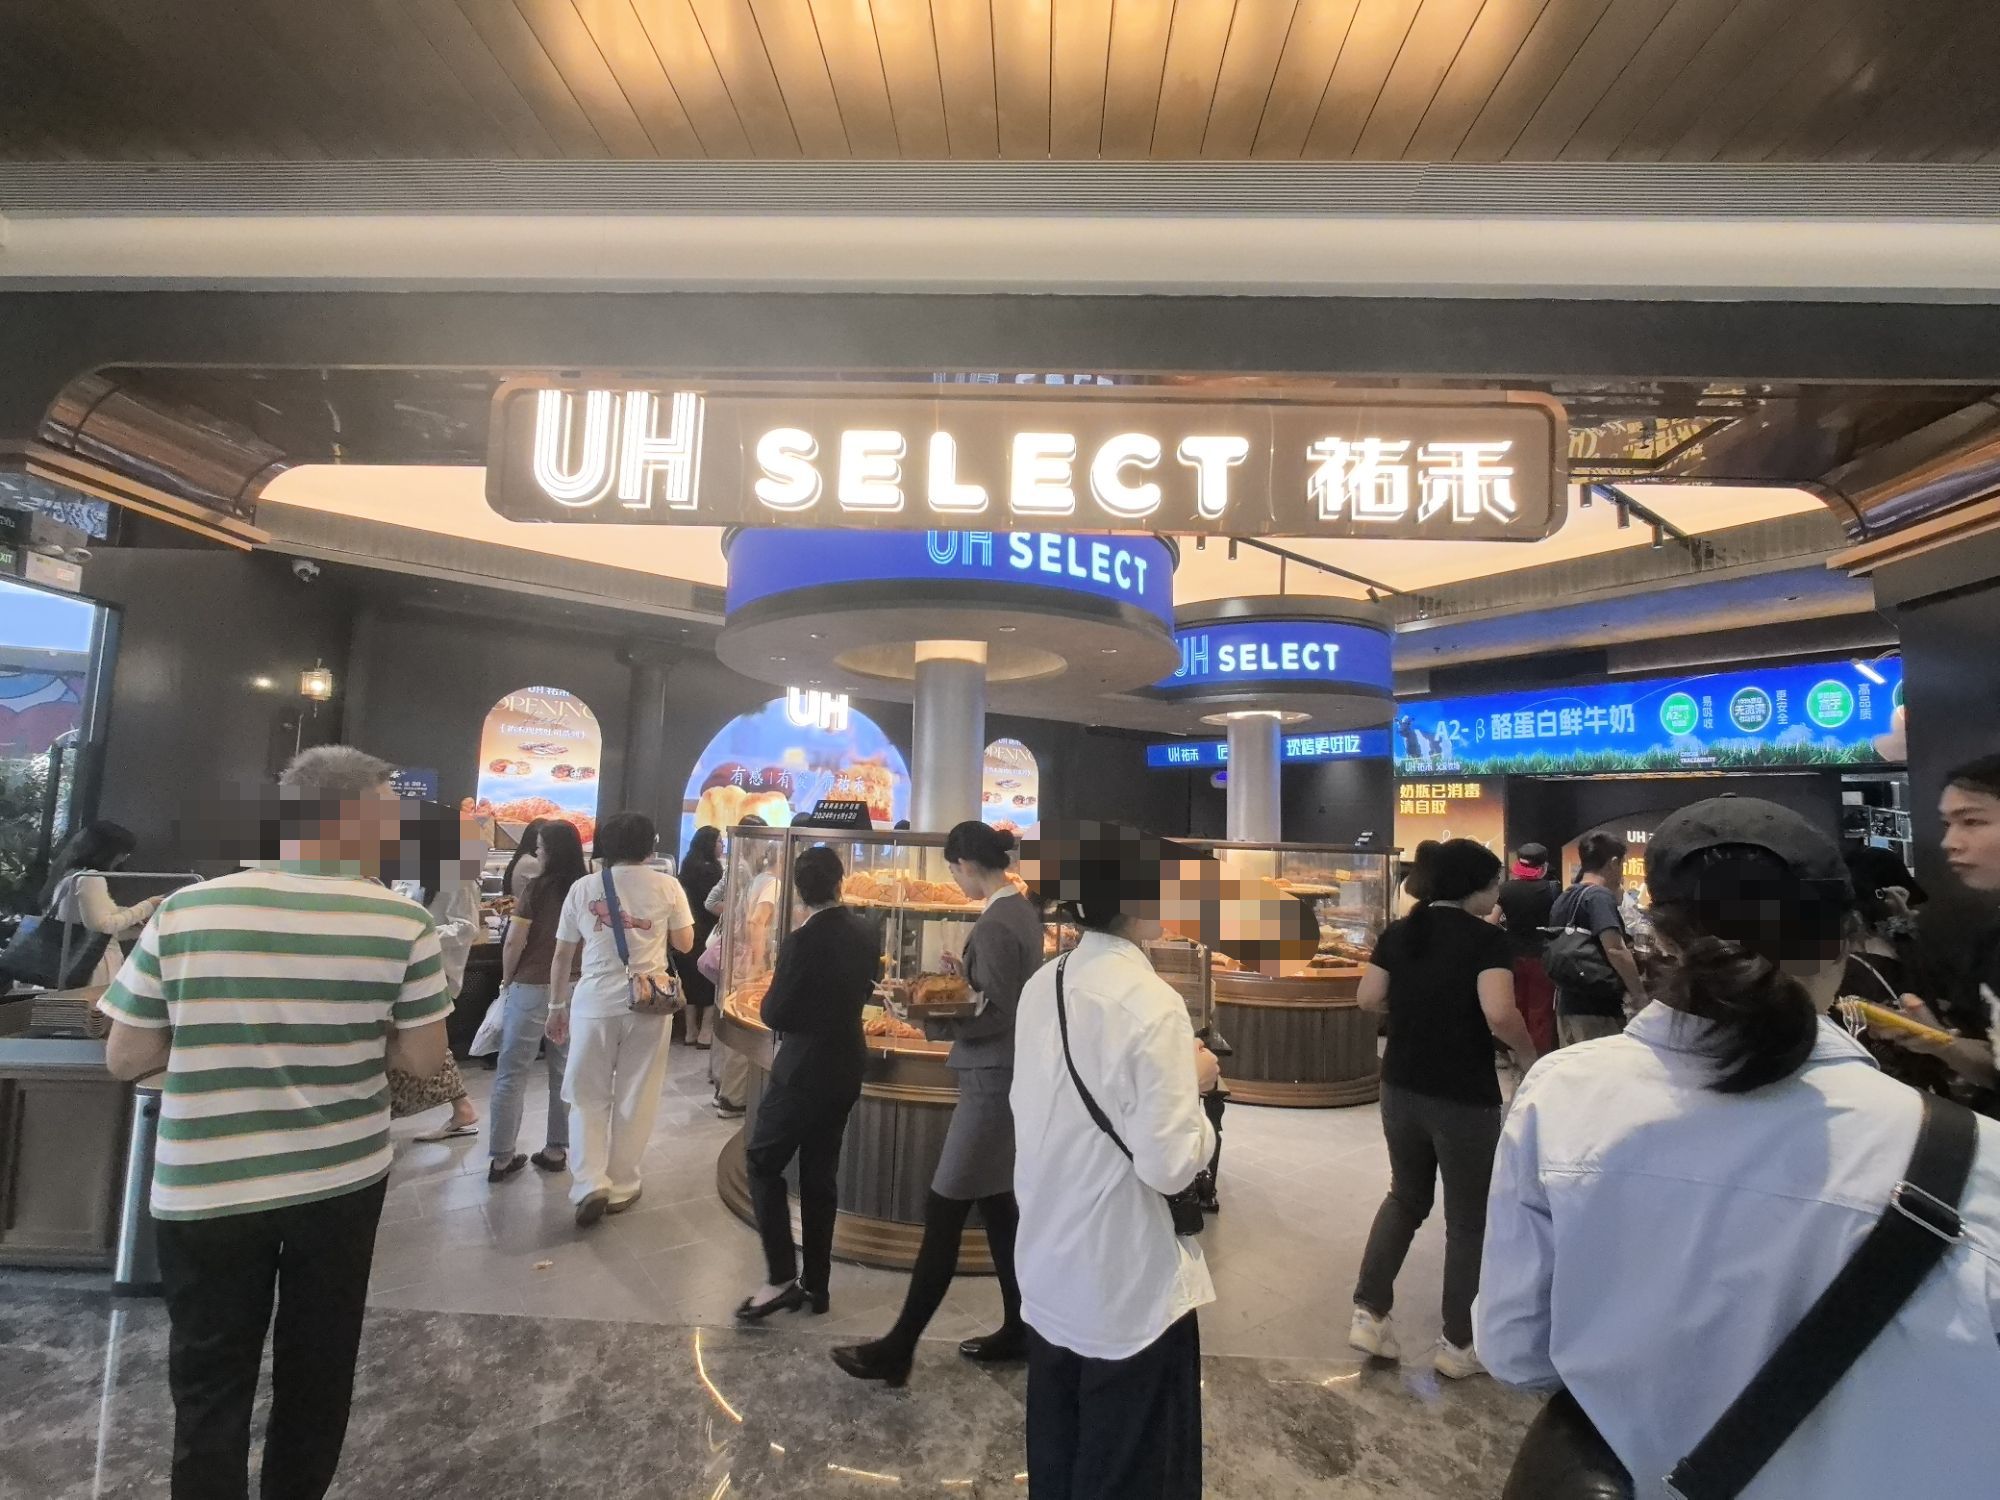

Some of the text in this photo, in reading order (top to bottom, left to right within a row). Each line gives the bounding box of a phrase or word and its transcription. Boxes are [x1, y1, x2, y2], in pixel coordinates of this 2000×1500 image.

[533, 388, 1519, 525] UH SELECT 祐禾
[1008, 531, 1147, 595] SELECT
[1218, 642, 1340, 672] SELECT
[785, 686, 849, 731] UH
[1168, 747, 1180, 762] UH
[1286, 735, 1361, 757] 现烤更好吃
[1399, 782, 1481, 799] 奶瓶已消毒
[1399, 799, 1447, 815] 请自取
[1626, 830, 1647, 843] UH
